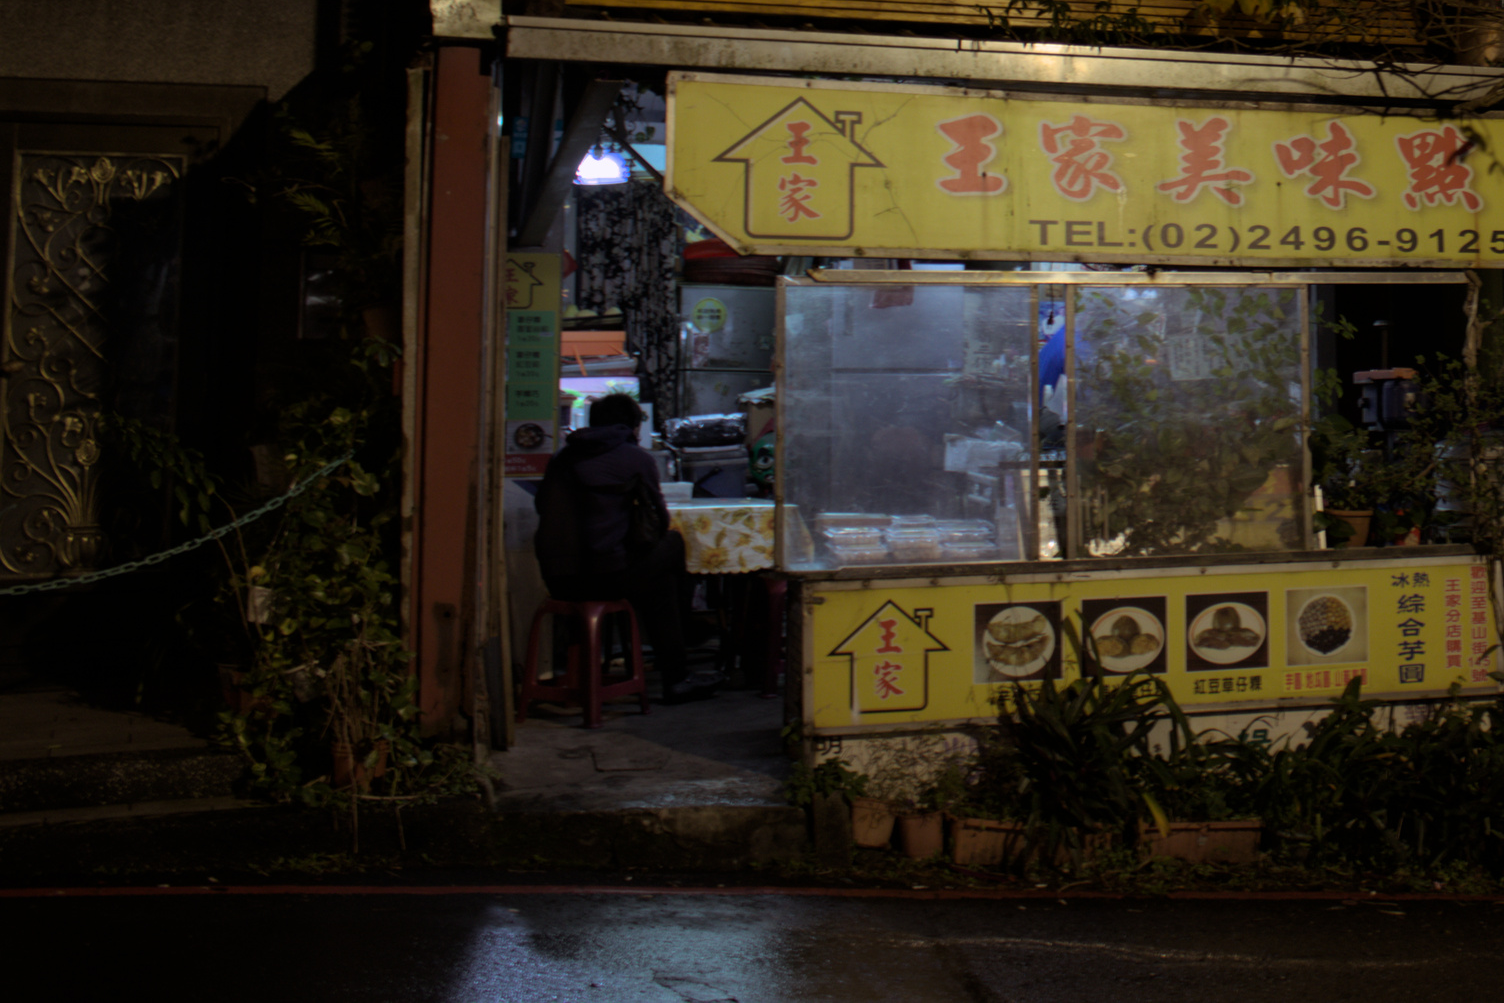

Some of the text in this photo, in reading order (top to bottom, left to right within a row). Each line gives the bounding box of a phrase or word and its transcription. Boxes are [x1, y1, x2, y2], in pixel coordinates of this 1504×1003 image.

[777, 120, 821, 224] 王家
[873, 618, 905, 700] 王家
[1396, 593, 1427, 684] 綜合芋圓
[1193, 674, 1263, 695] 紅豆草仔粿
